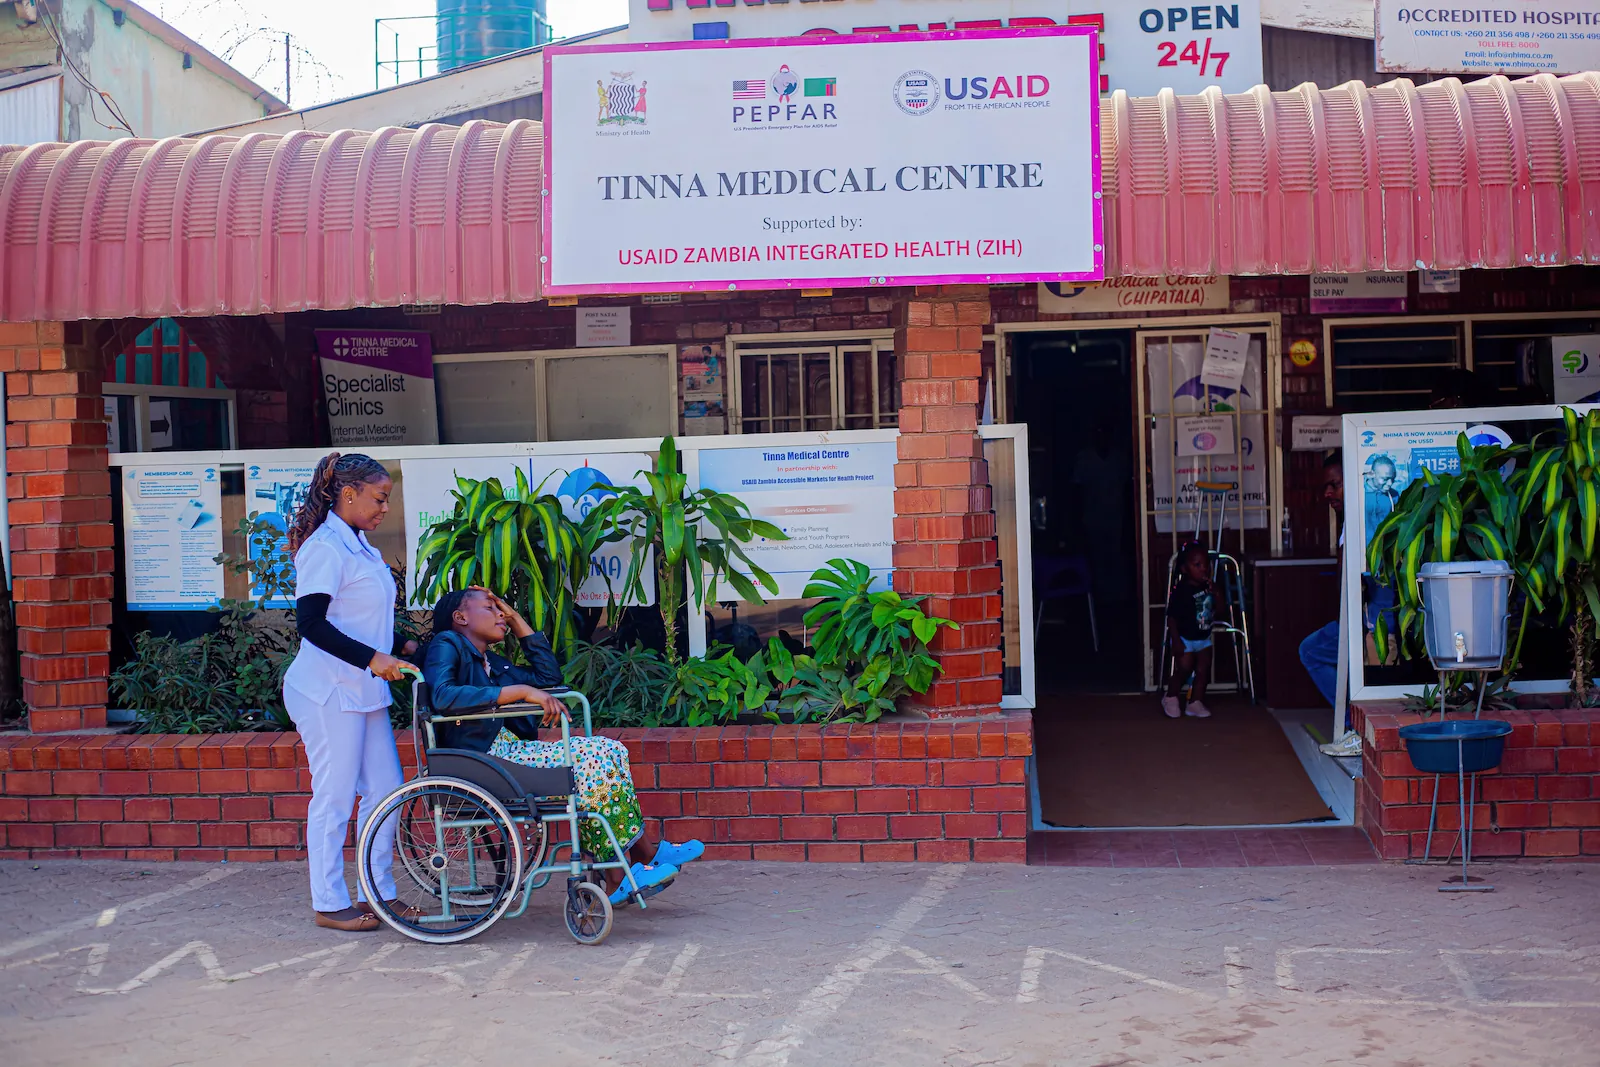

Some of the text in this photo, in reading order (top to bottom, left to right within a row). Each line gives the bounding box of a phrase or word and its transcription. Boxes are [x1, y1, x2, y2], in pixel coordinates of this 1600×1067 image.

[1139, 3, 1240, 33] OPEN
[1398, 8, 1517, 24] ACCREDITED
[1464, 30, 1483, 38] +260
[1157, 37, 1230, 77] 24/7
[1488, 51, 1553, 59] info@nhima.co.zm
[944, 74, 1050, 100] USAID
[732, 104, 838, 122] PEPFAR
[598, 162, 1044, 200] TINNA MEDICAL CENTRE
[762, 214, 862, 233] Supported by:
[618, 238, 1023, 265] USAID ZAMBIA INTEGRATED HEALTH (ZIH)
[1314, 276, 1404, 284] CONTINUM INSURANCE
[1118, 287, 1205, 307] (CHIPATALA)
[350, 337, 418, 348] TINNA MEDICAL
[351, 347, 388, 357] CENTRE
[325, 374, 405, 397] Specialist
[327, 398, 384, 416] Clinics
[332, 424, 406, 436] Internal Medicine
[762, 450, 849, 461] Tinna Medical Centre
[581, 592, 588, 600] No
[590, 592, 601, 600] One
[603, 591, 623, 600] Beind
